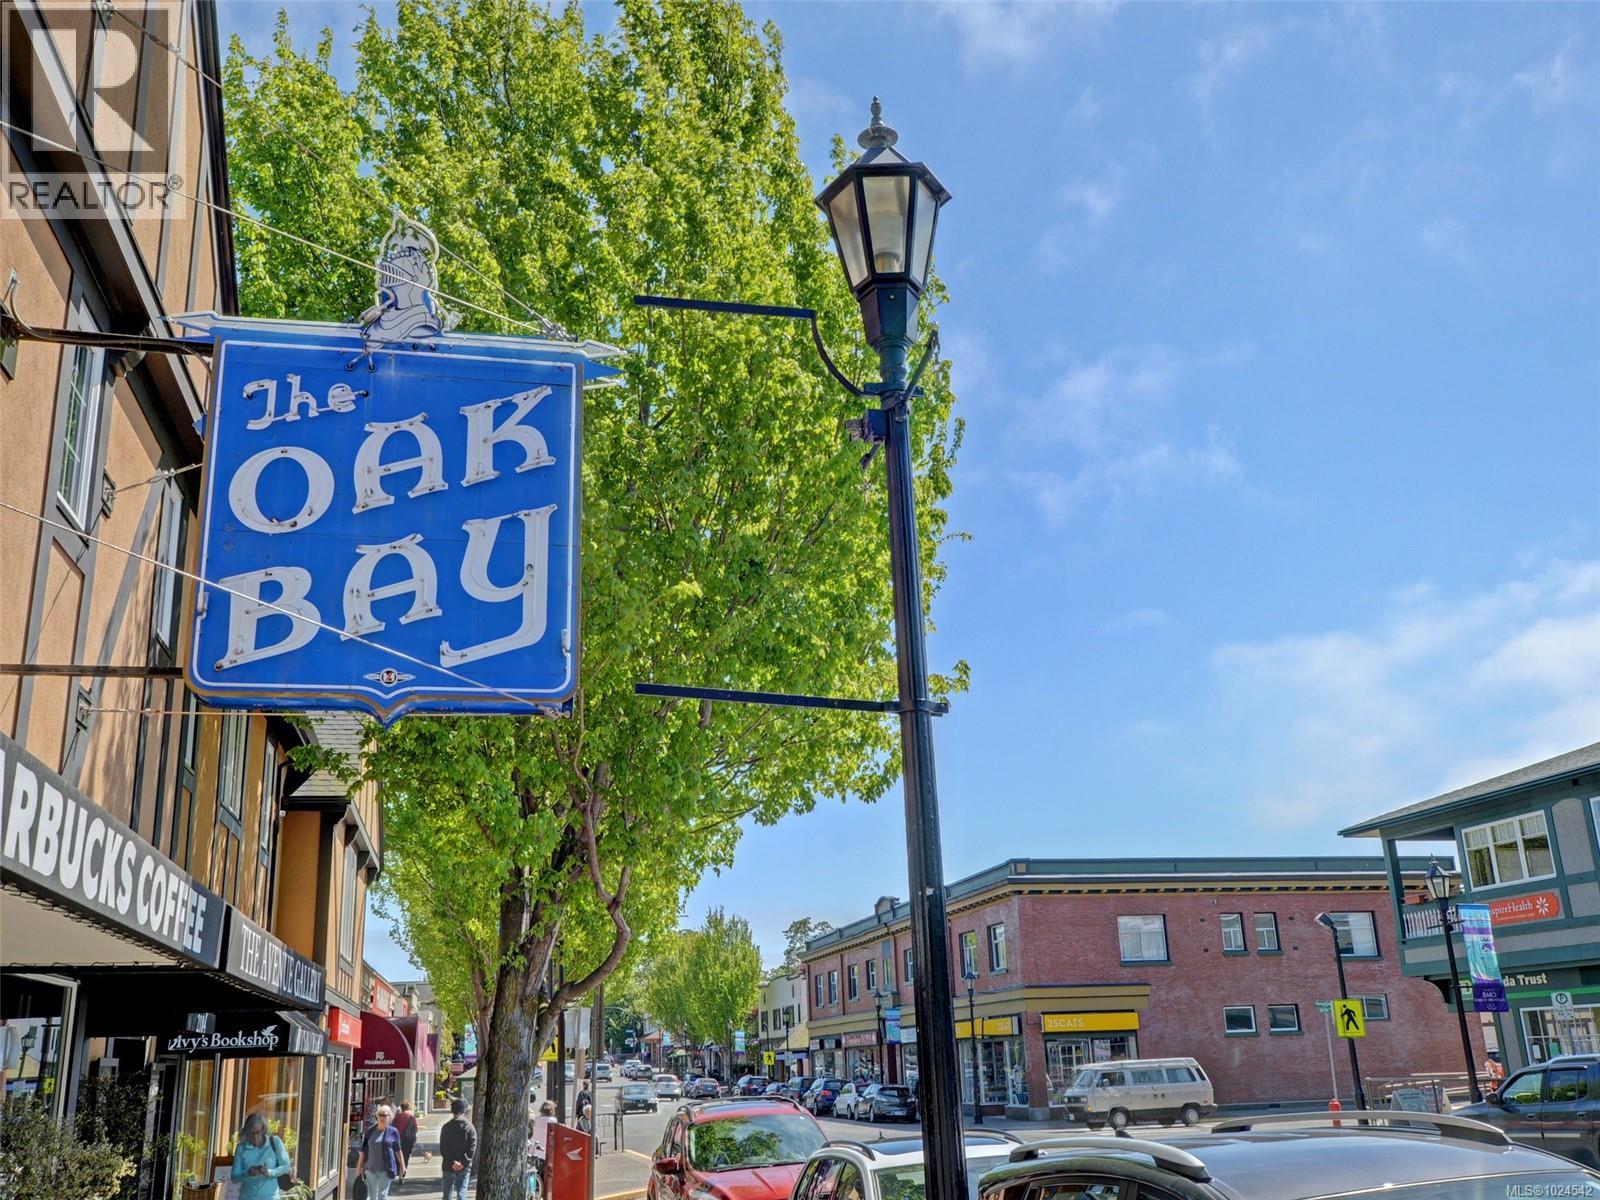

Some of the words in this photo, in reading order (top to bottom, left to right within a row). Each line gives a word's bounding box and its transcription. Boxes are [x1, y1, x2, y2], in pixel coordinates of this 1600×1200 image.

[242, 373, 369, 430] The
[227, 385, 557, 535] OAK
[214, 503, 559, 672] BAY
[0, 747, 137, 916] RBUCKS
[136, 854, 208, 954] COFFEE
[1491, 899, 1534, 918] spireHealth
[239, 924, 262, 978] THE
[260, 938, 294, 995] AVENUE
[1503, 975, 1516, 987] da
[1516, 972, 1548, 986] Trust
[168, 1034, 209, 1054] Ivy's
[210, 1030, 279, 1052] Bookshop
